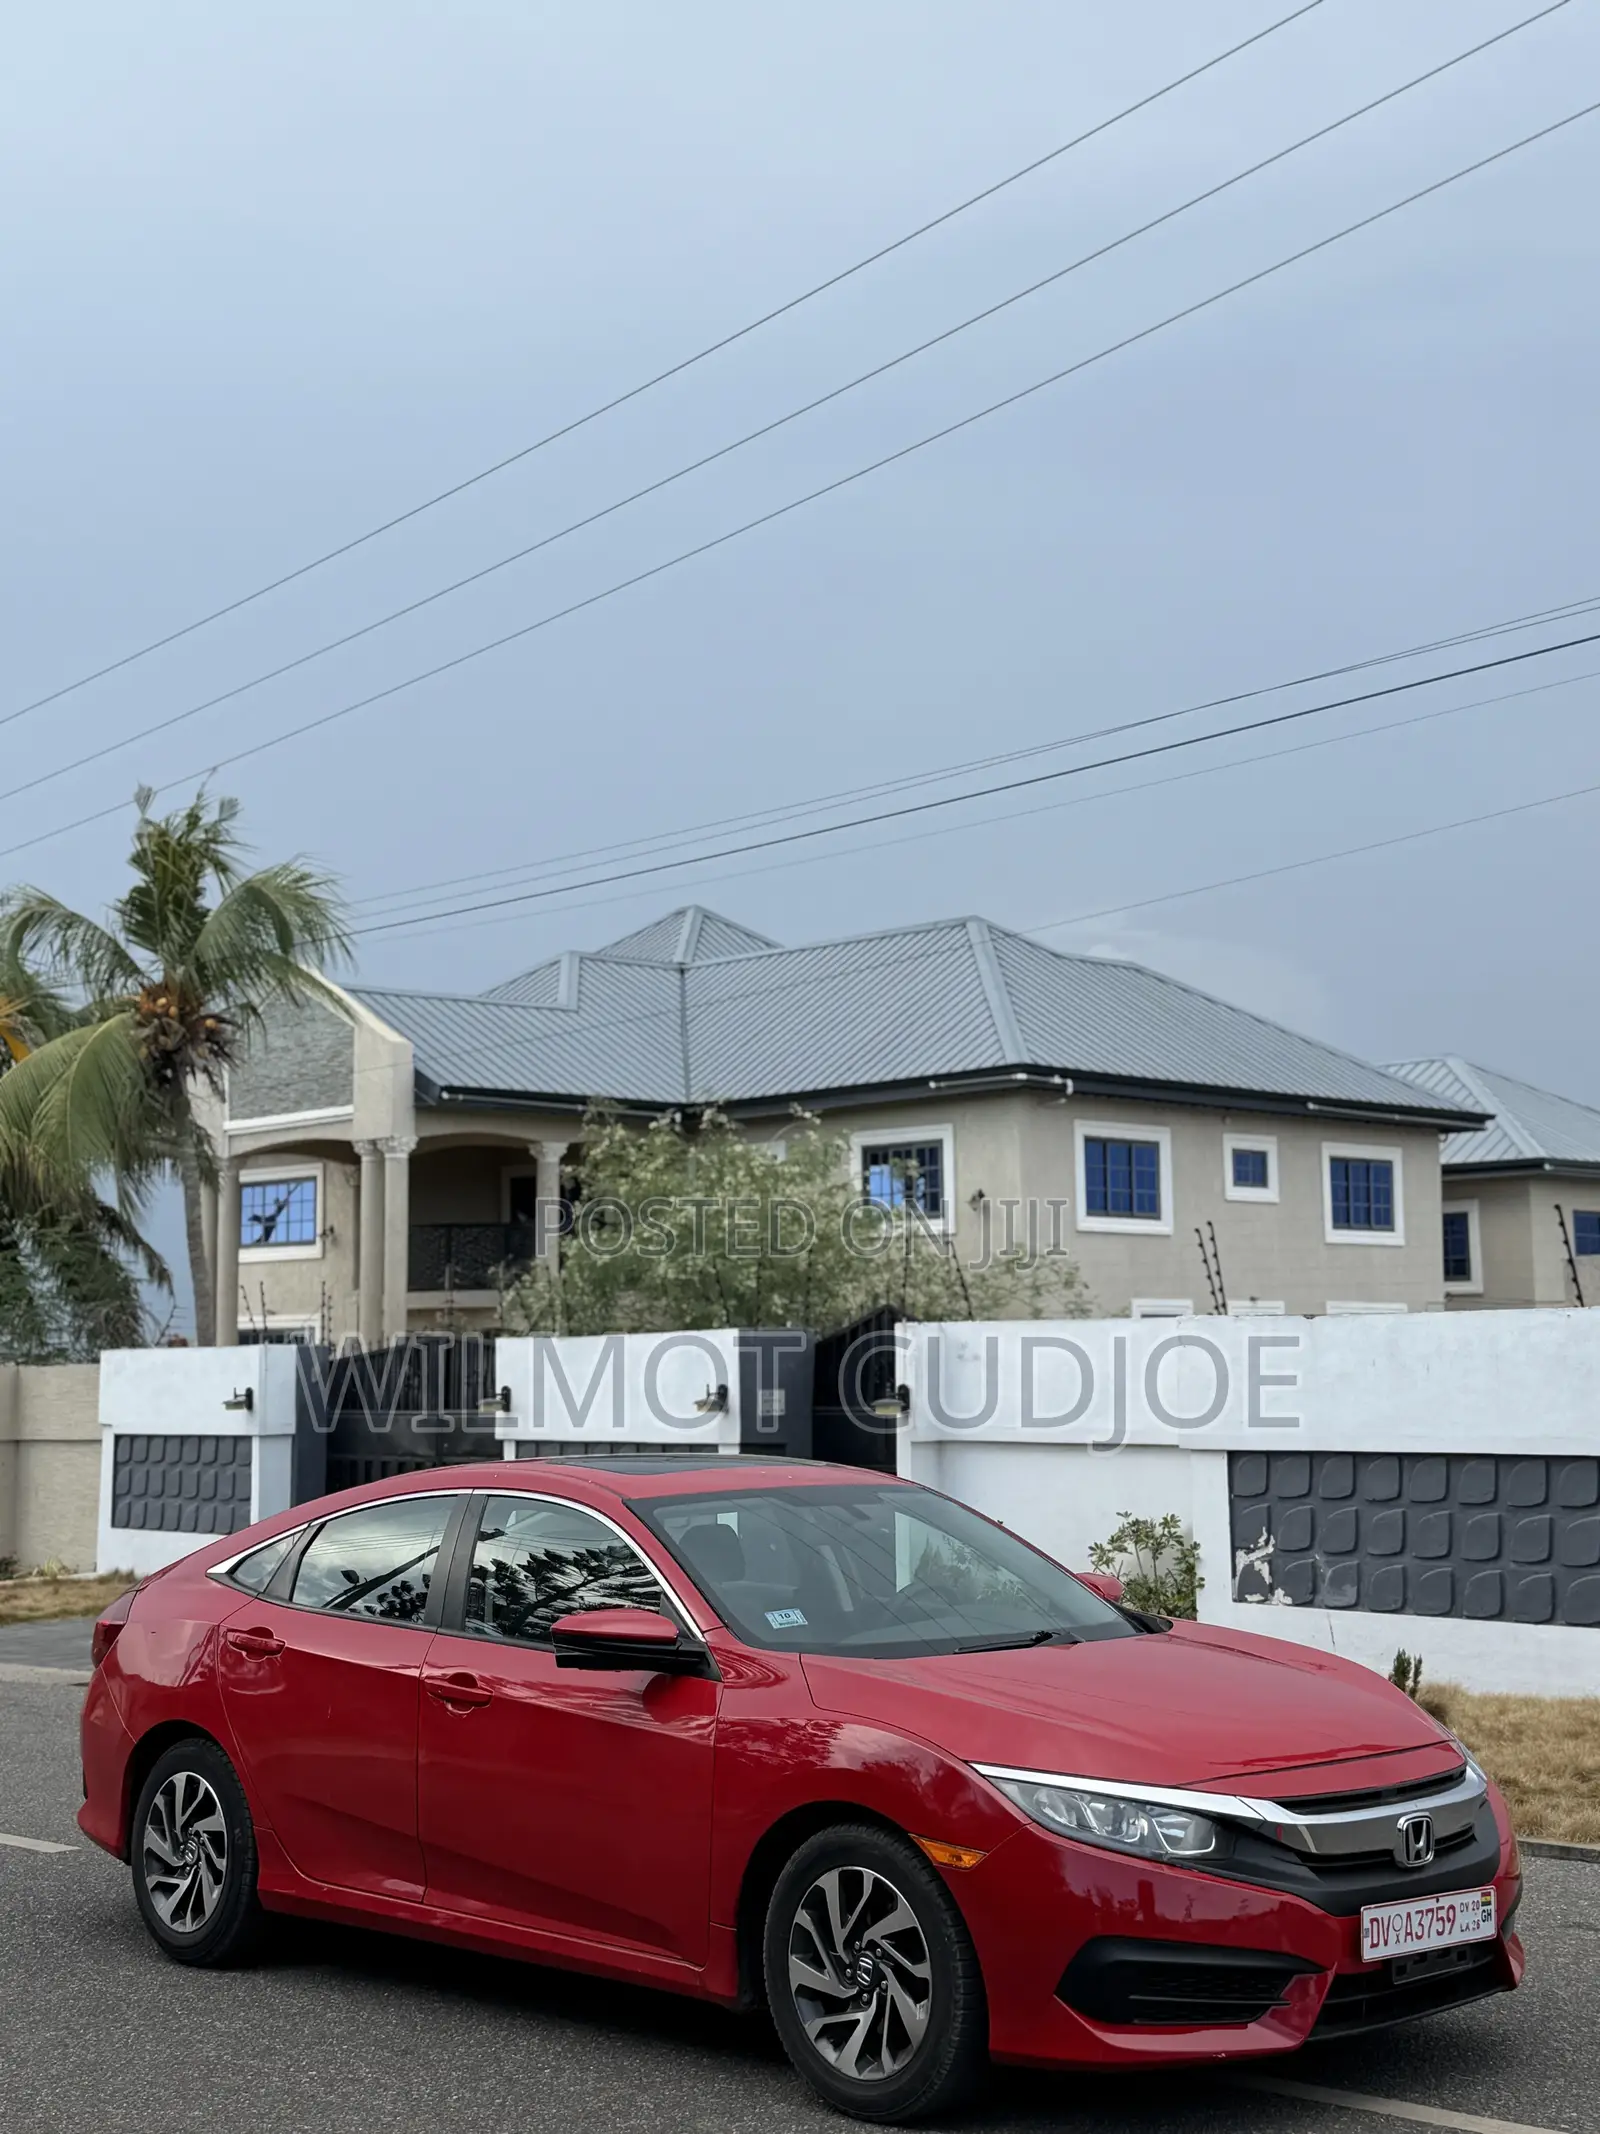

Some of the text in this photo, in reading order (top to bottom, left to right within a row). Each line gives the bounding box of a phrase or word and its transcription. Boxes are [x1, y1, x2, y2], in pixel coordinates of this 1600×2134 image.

[779, 1612, 791, 1620] 10
[1481, 1908, 1492, 1923] GH
[1369, 1904, 1456, 1949] DV A3759
